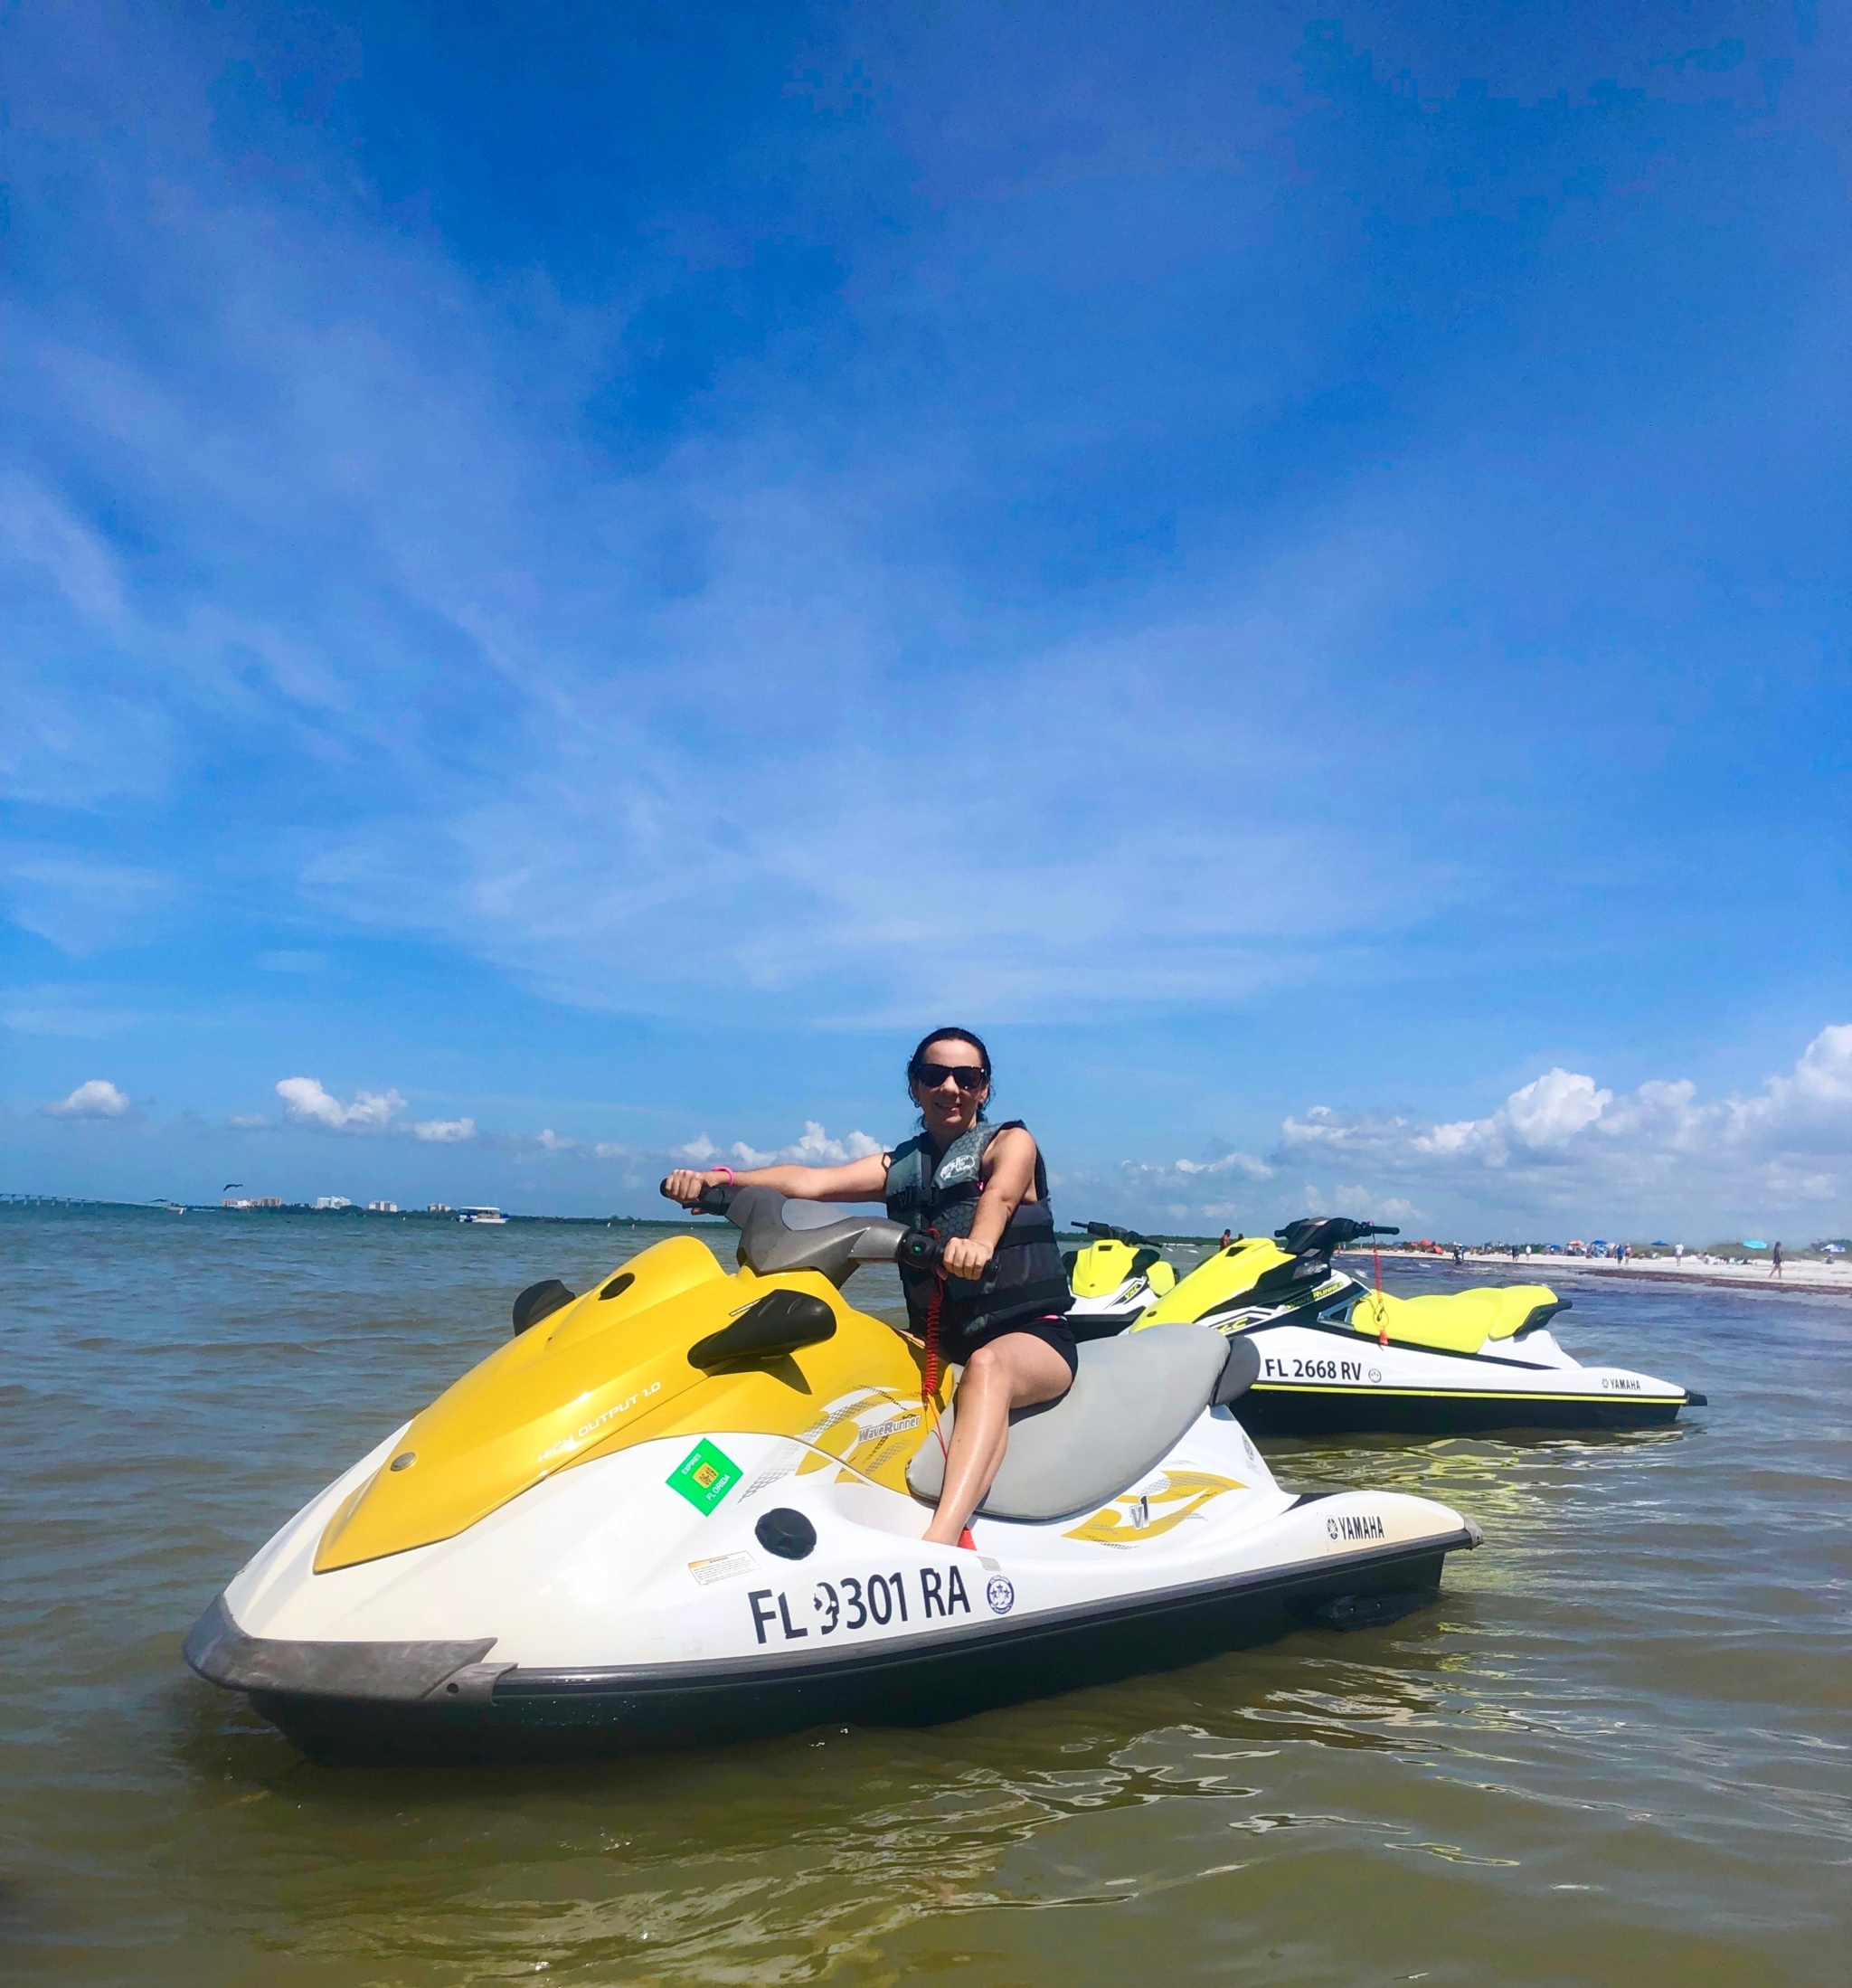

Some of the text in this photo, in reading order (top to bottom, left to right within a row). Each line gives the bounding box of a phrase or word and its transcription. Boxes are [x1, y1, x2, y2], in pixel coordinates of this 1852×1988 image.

[1265, 1358, 1361, 1380] FL 2668 RV
[1610, 1378, 1641, 1390] YAMAHA
[578, 1394, 638, 1437] OUTPUT
[642, 1381, 661, 1397] 1.0
[857, 1415, 921, 1444] WaveRunner
[681, 1453, 702, 1475] EXPIRES
[705, 1473, 732, 1501] FLORIDA
[1338, 1516, 1384, 1540] YAMAHA
[747, 1589, 808, 1644] FL
[920, 1566, 971, 1618] RA
